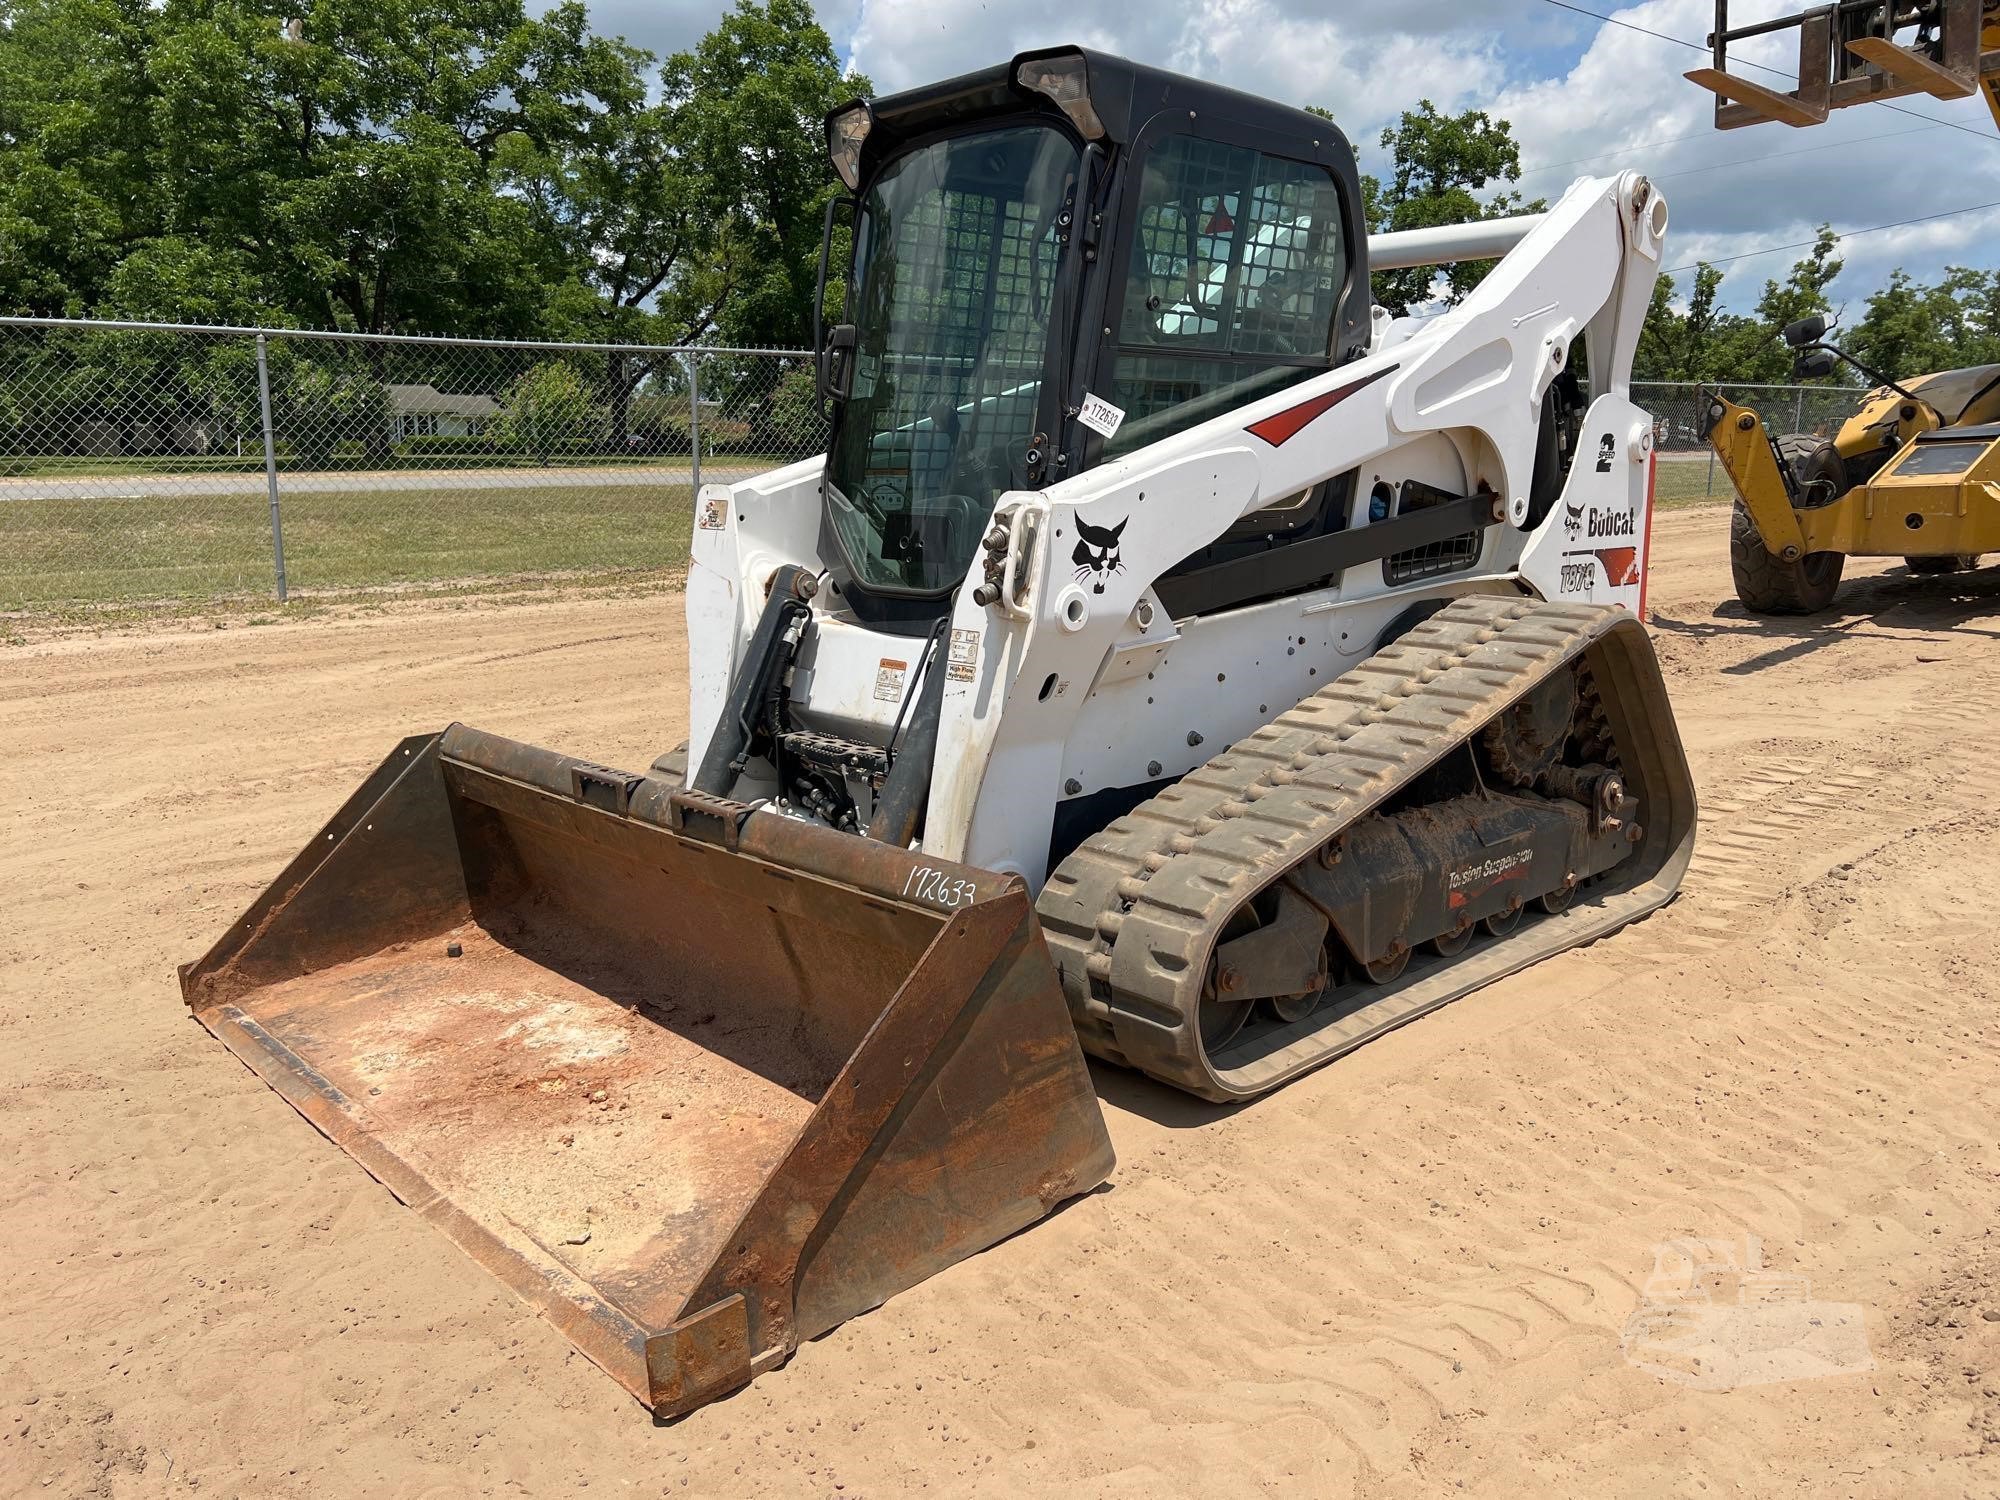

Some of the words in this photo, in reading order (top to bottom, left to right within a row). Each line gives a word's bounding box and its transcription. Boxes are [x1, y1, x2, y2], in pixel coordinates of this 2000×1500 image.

[1091, 403, 1119, 427] 172633
[1598, 450, 1616, 459] SPEED
[1588, 507, 1635, 537] Bobcat
[1560, 563, 1595, 593] T870
[903, 865, 976, 906] 172633
